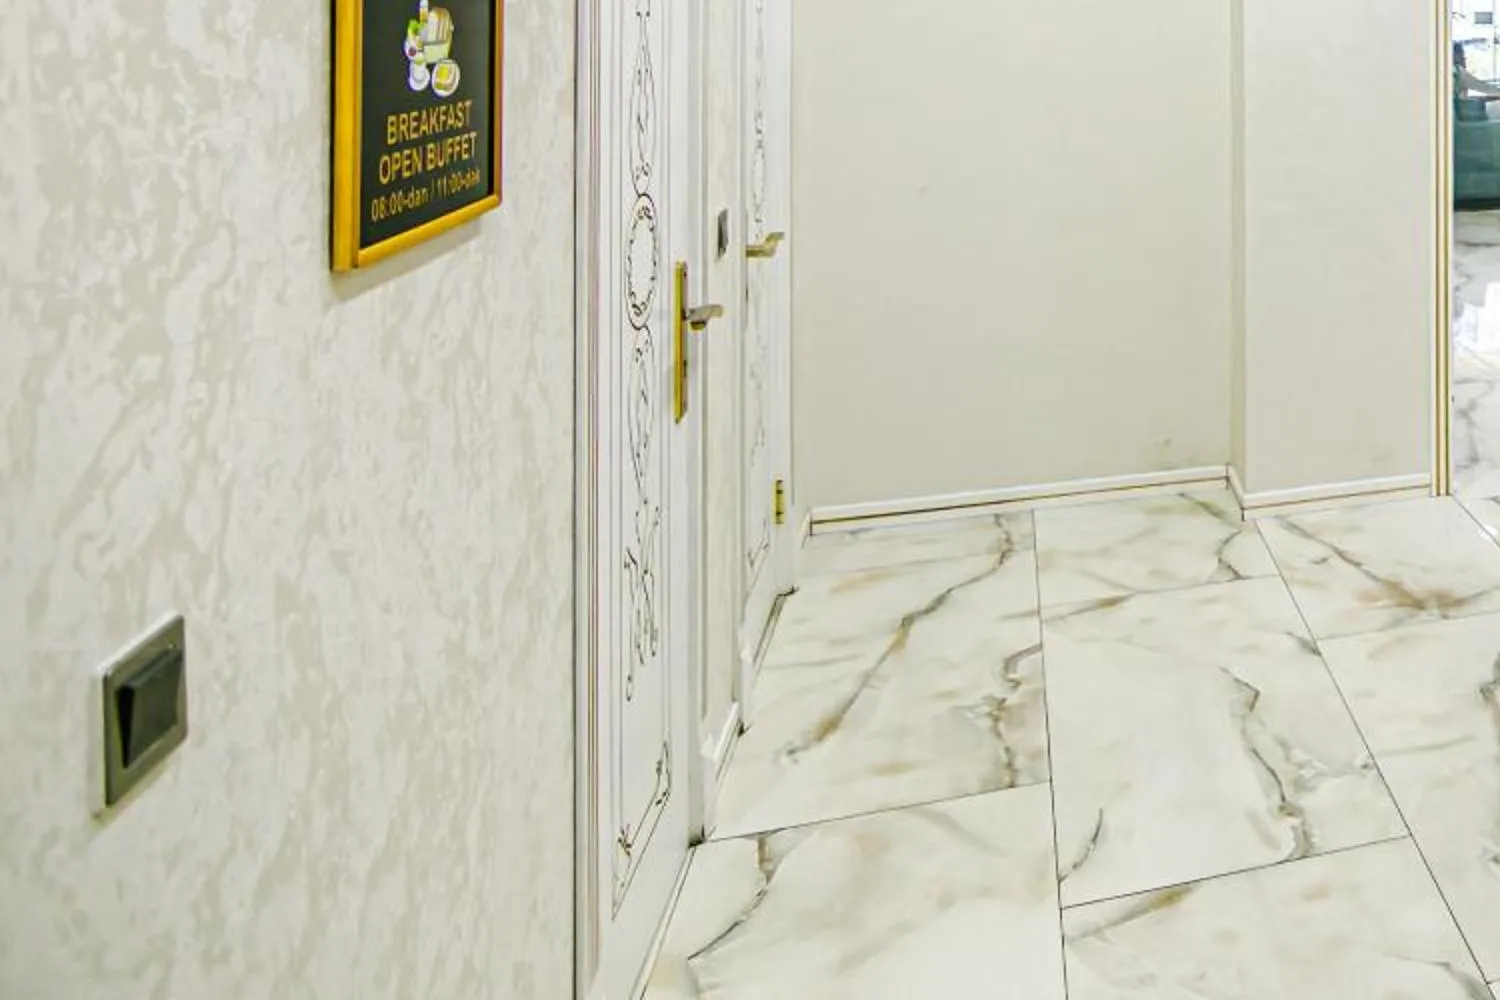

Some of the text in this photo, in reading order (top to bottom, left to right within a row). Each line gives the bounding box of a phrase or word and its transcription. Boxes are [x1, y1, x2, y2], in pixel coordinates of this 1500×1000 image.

[386, 100, 472, 145] BREAKFAST
[379, 131, 477, 185] OPEN BUFFET
